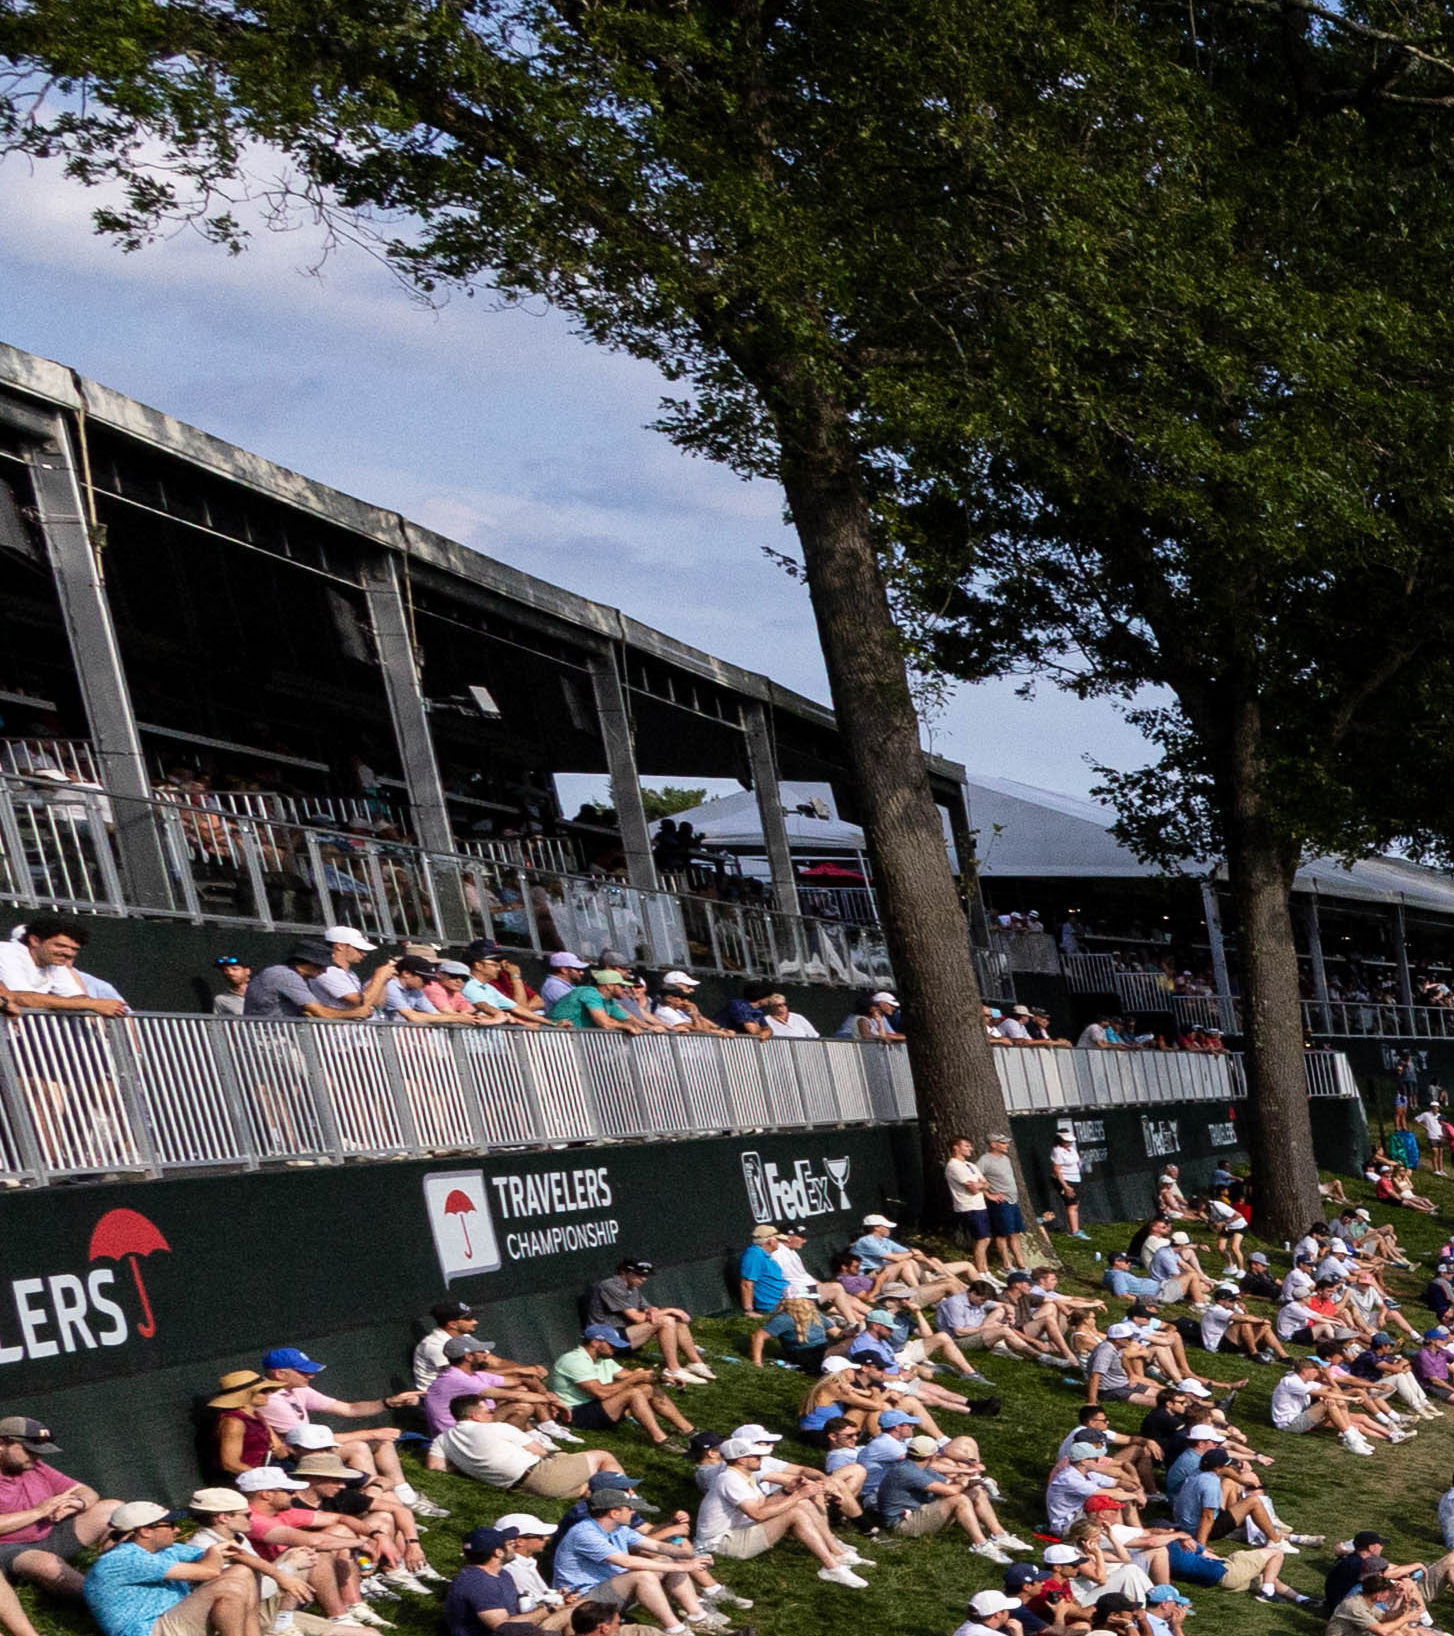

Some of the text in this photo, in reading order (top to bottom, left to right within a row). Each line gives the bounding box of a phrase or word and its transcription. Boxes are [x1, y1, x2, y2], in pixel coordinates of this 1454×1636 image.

[491, 1167, 613, 1219] TRAVELERS
[764, 1159, 836, 1221] FedEx
[506, 1219, 620, 1260] CHAMPIONSHIP
